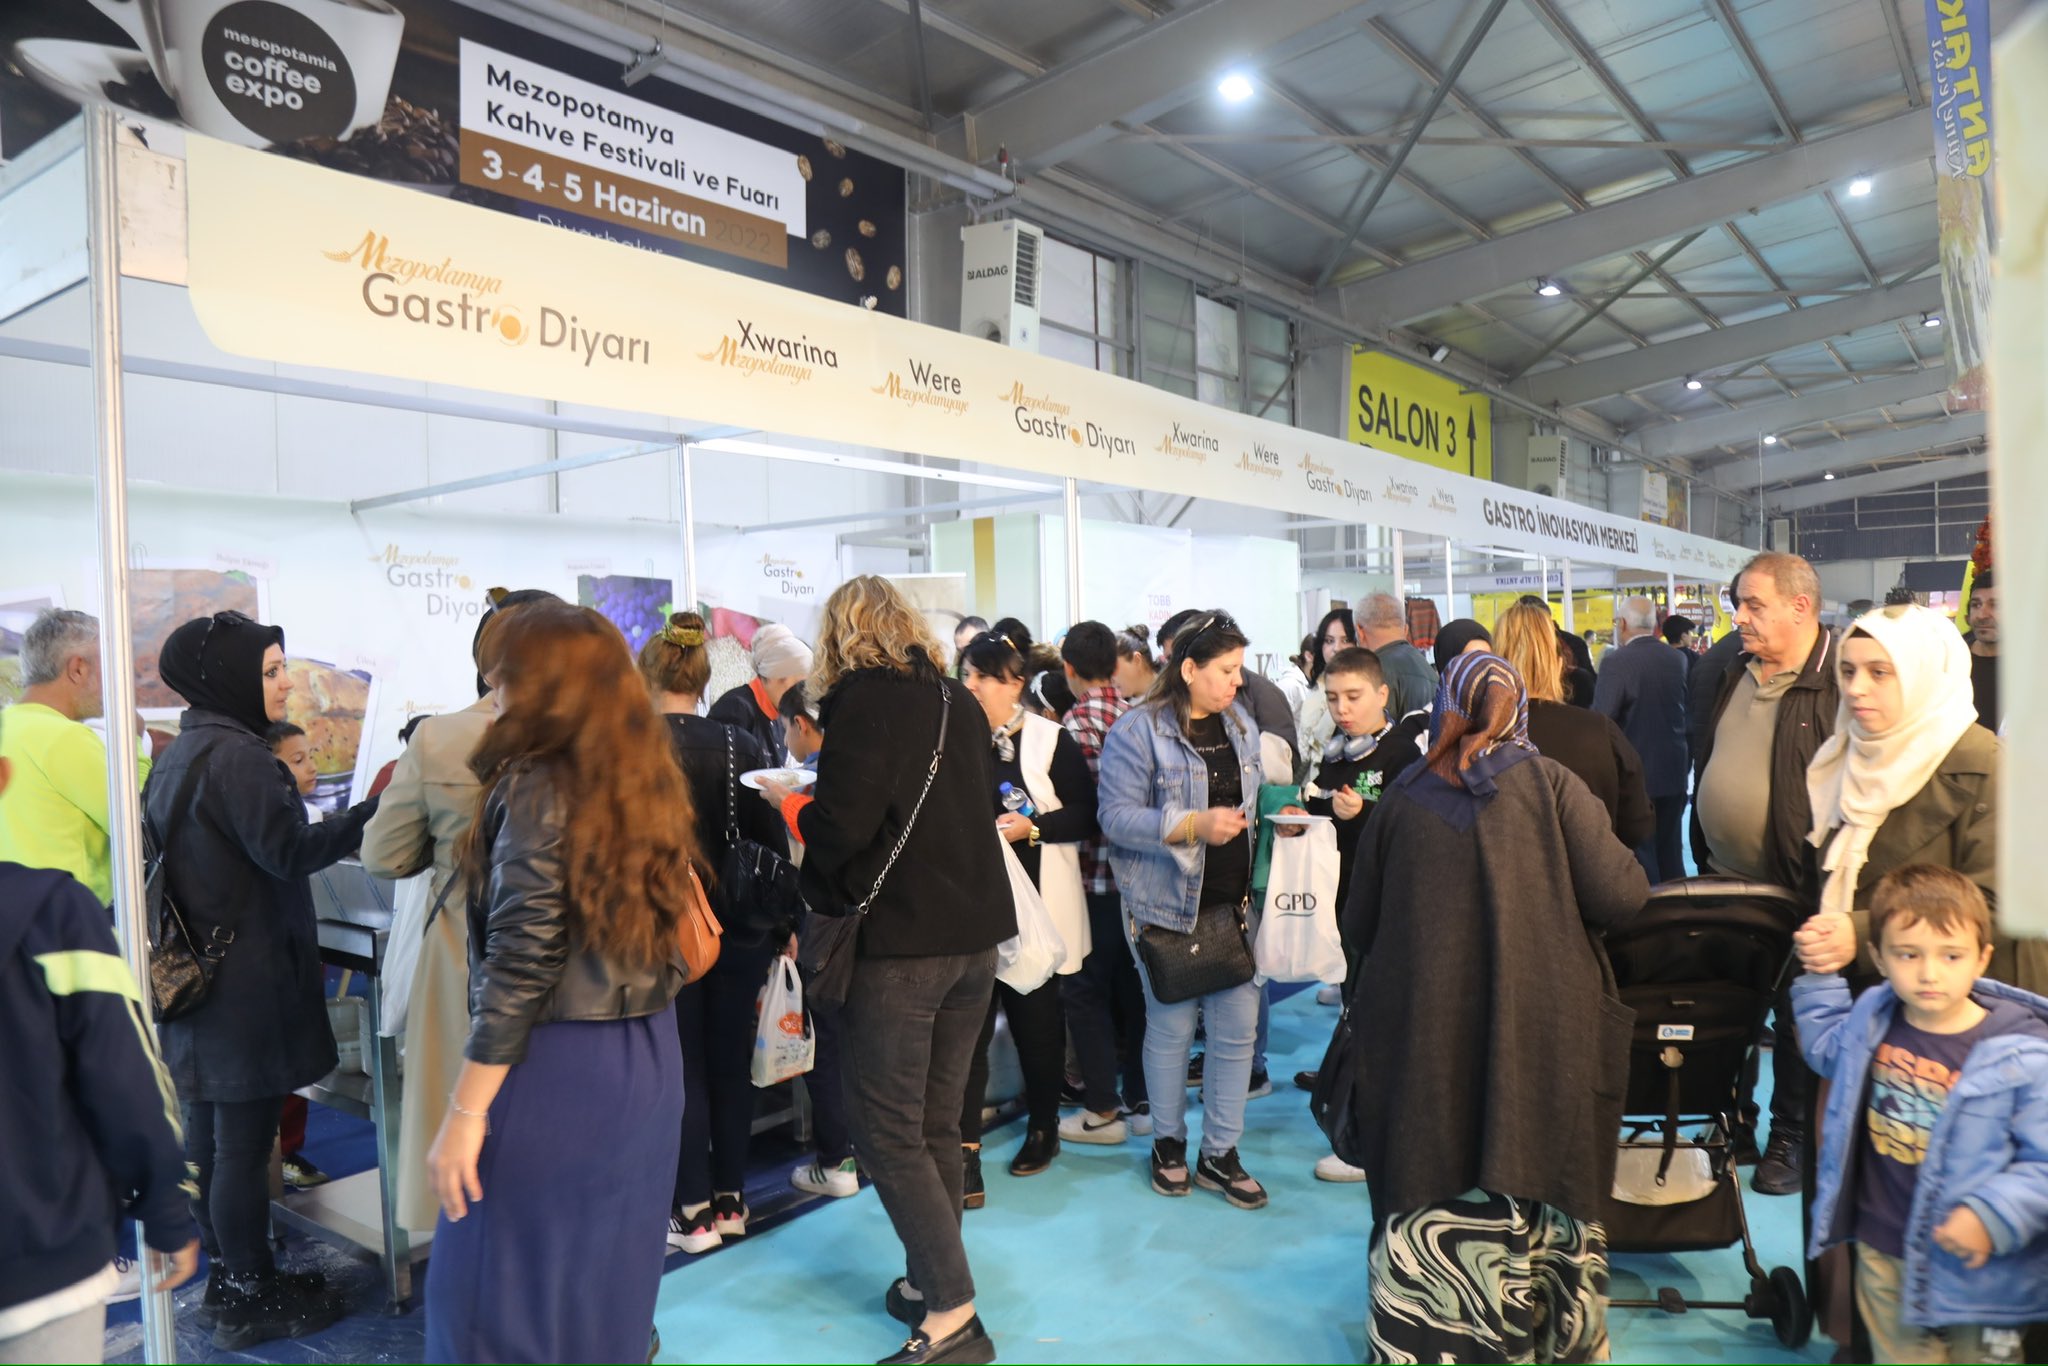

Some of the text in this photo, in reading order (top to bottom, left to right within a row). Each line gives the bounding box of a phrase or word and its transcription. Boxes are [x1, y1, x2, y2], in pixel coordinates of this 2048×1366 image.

[224, 27, 337, 72] mesopotamia
[224, 50, 322, 94] coffee
[225, 73, 304, 110] expo
[486, 64, 674, 145] Mezopotamya
[486, 101, 780, 210] Kahve Festivali ve Fuarı
[594, 181, 707, 237] Haziran
[715, 219, 771, 255] 2022
[349, 229, 503, 297] Mezopotamya
[539, 306, 651, 367] Diyarı
[738, 319, 839, 368] Xwarina
[909, 358, 962, 395] Were
[1172, 422, 1219, 452] Xwarina
[1358, 384, 1457, 457] SALON 3
[1086, 422, 1136, 458] Diyarı
[1254, 442, 1279, 465] Were
[1344, 480, 1373, 506] Diyarı
[1389, 475, 1418, 496] Xwarina
[1437, 488, 1455, 504] Were
[1483, 498, 1536, 534] GASTRO
[1536, 504, 1600, 548] İNOVASYON
[1600, 526, 1639, 554] MERKEZİ
[781, 580, 814, 597] Diyarı
[1148, 594, 1171, 606] TOBB
[1275, 893, 1317, 911] GPD
